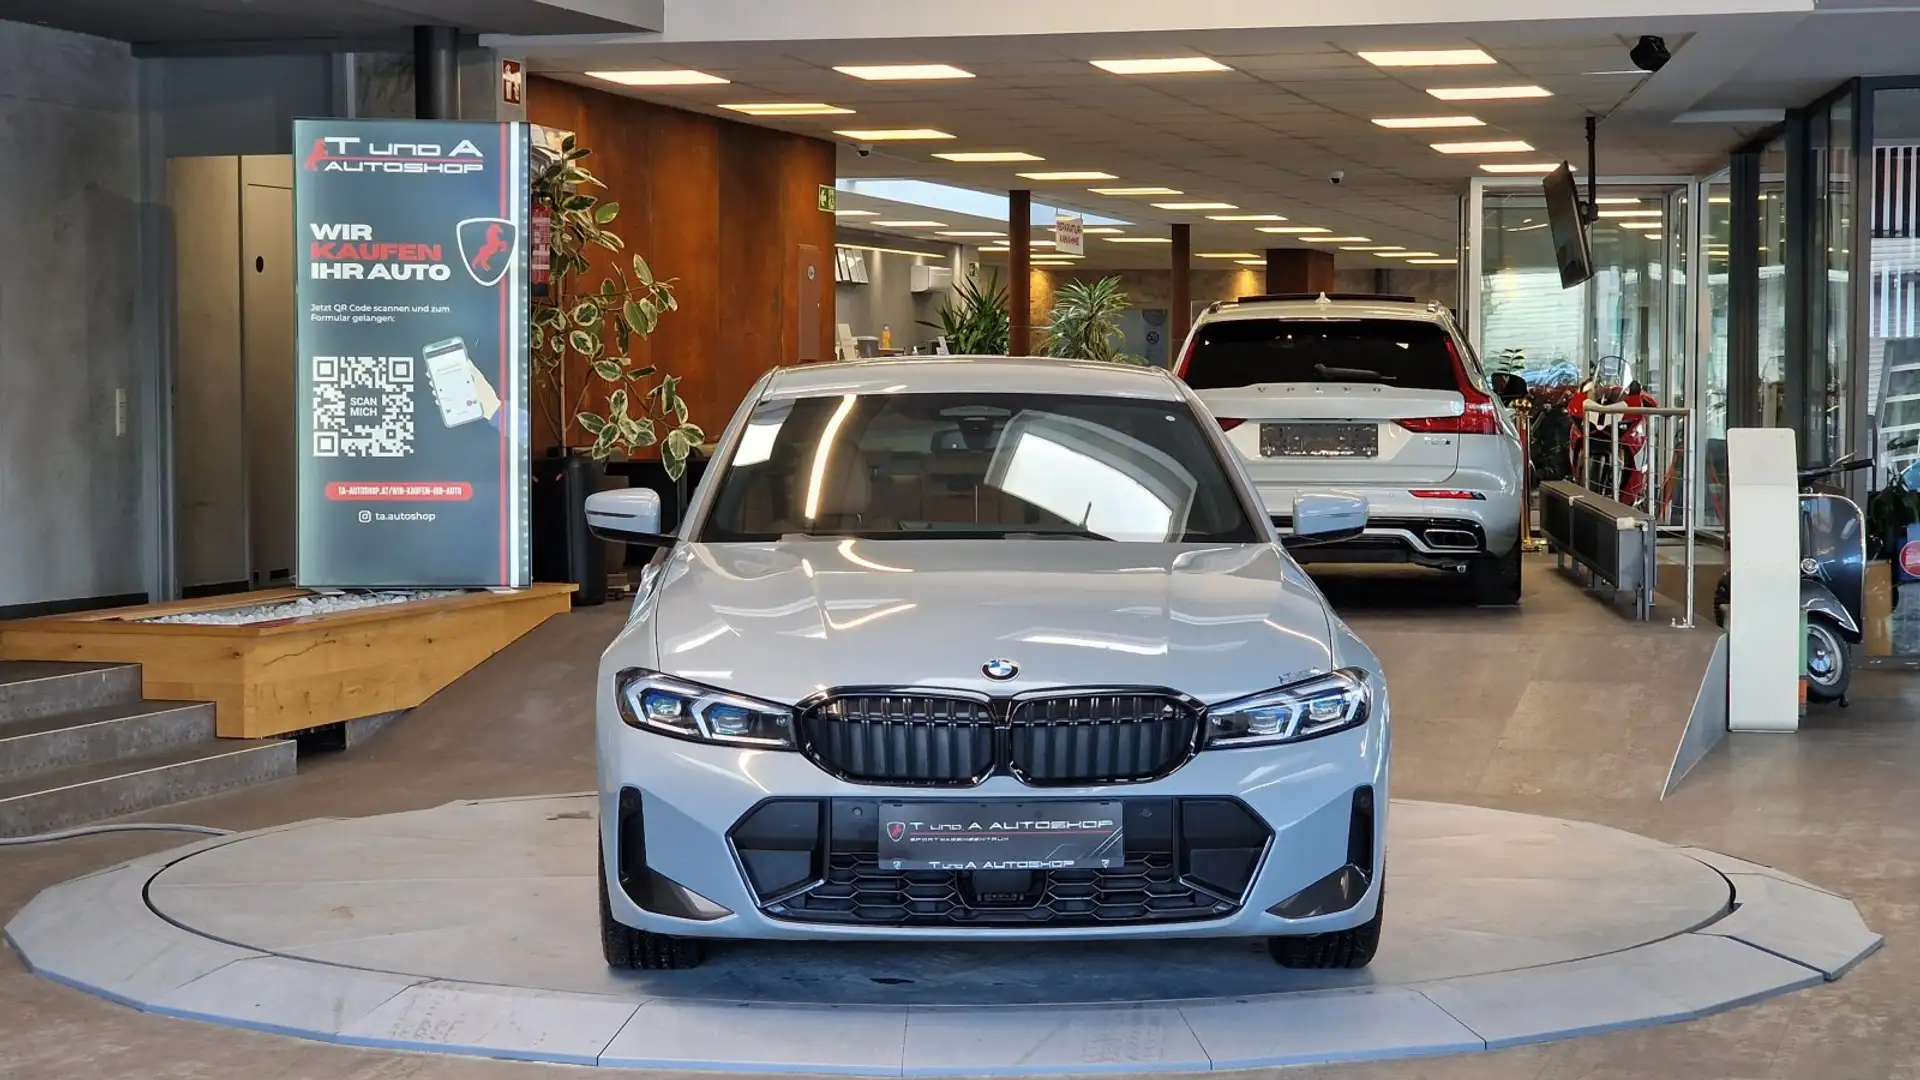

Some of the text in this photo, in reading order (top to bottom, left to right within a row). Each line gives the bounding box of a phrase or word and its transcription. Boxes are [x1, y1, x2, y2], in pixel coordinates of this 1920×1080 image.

[324, 137, 360, 154] T
[448, 139, 484, 157] A
[324, 161, 484, 174] AUTOSHOP
[310, 223, 373, 241] WIR
[310, 243, 443, 261] KAUFEN
[311, 263, 451, 281] IHR AUTO
[310, 304, 332, 312] Jetzt
[333, 304, 347, 313] QR
[349, 304, 372, 312] Code
[373, 305, 409, 313] scannen
[411, 304, 429, 313] und
[310, 314, 350, 322] Formular
[350, 397, 378, 406] SCAN
[350, 407, 378, 417] MICH
[374, 512, 436, 523] ta.autoshop
[909, 822, 924, 831] T
[967, 822, 982, 831] A
[988, 821, 1114, 831] AUTOSHOP
[983, 860, 1075, 869] AUTOSHOP
